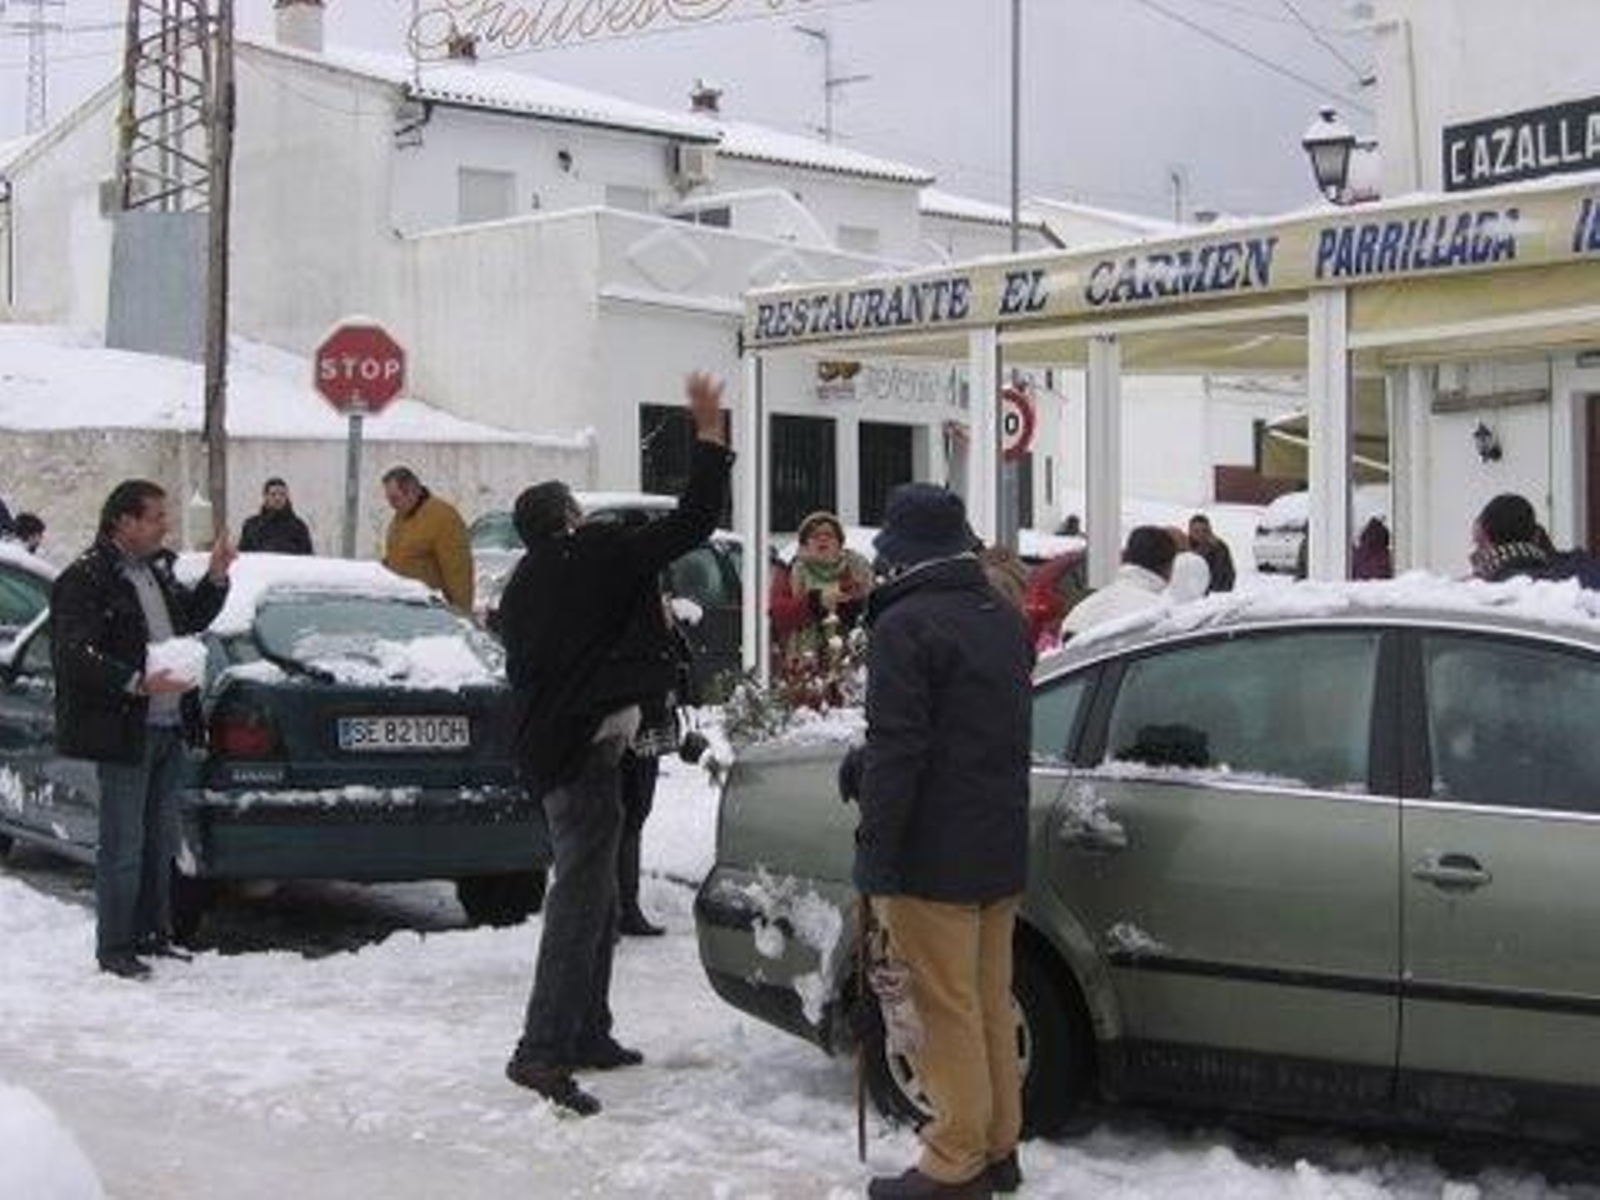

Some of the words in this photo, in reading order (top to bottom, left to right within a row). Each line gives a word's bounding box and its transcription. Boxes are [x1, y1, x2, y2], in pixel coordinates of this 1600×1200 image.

[1451, 113, 1600, 183] CAZALLA
[754, 277, 971, 340] RESTAURANTE
[999, 269, 1049, 315] EL
[1085, 237, 1278, 306] CARMEN
[1315, 207, 1519, 280] PARRILLADA
[321, 357, 400, 380] STOP
